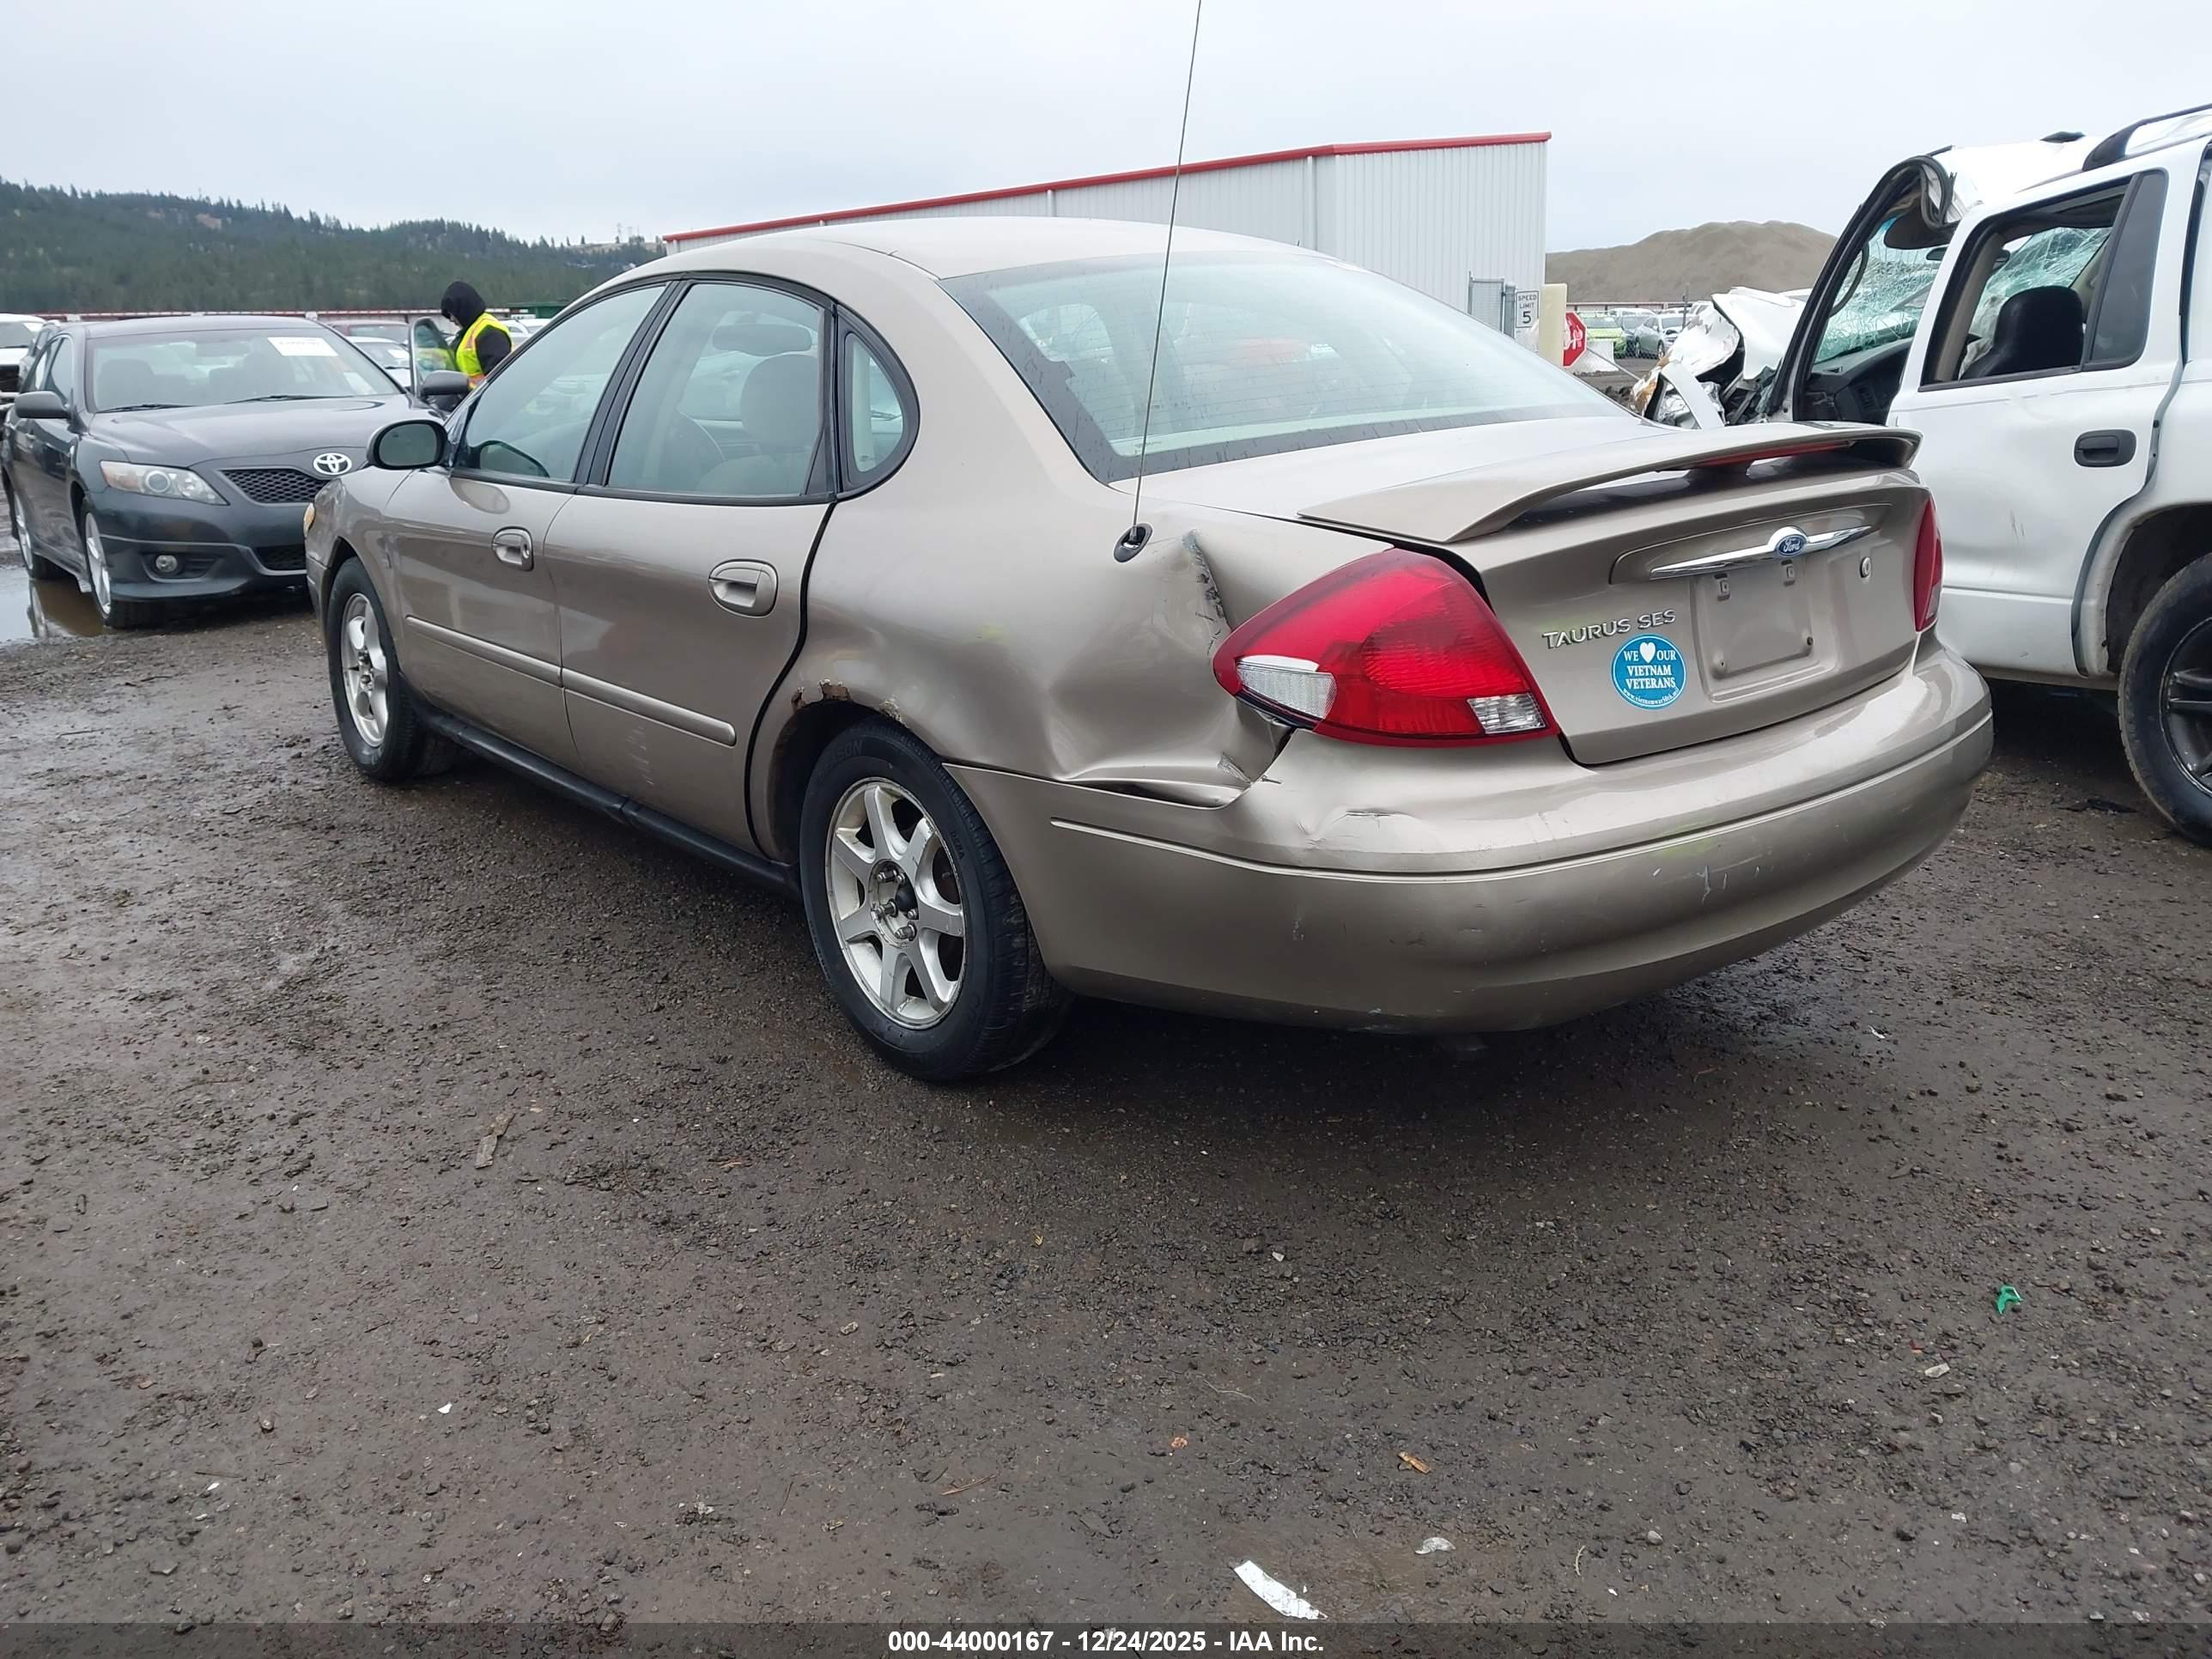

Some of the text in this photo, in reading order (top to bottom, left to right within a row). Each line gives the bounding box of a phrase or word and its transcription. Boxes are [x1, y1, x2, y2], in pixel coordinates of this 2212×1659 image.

[1522, 311, 1532, 324] 5
[1783, 538, 1802, 552] Ford
[1542, 609, 1676, 648] TAURUS SES
[1624, 650, 1676, 661] WE OUR
[1626, 665, 1672, 677] VIETNAM
[1625, 677, 1676, 690] VETERANS
